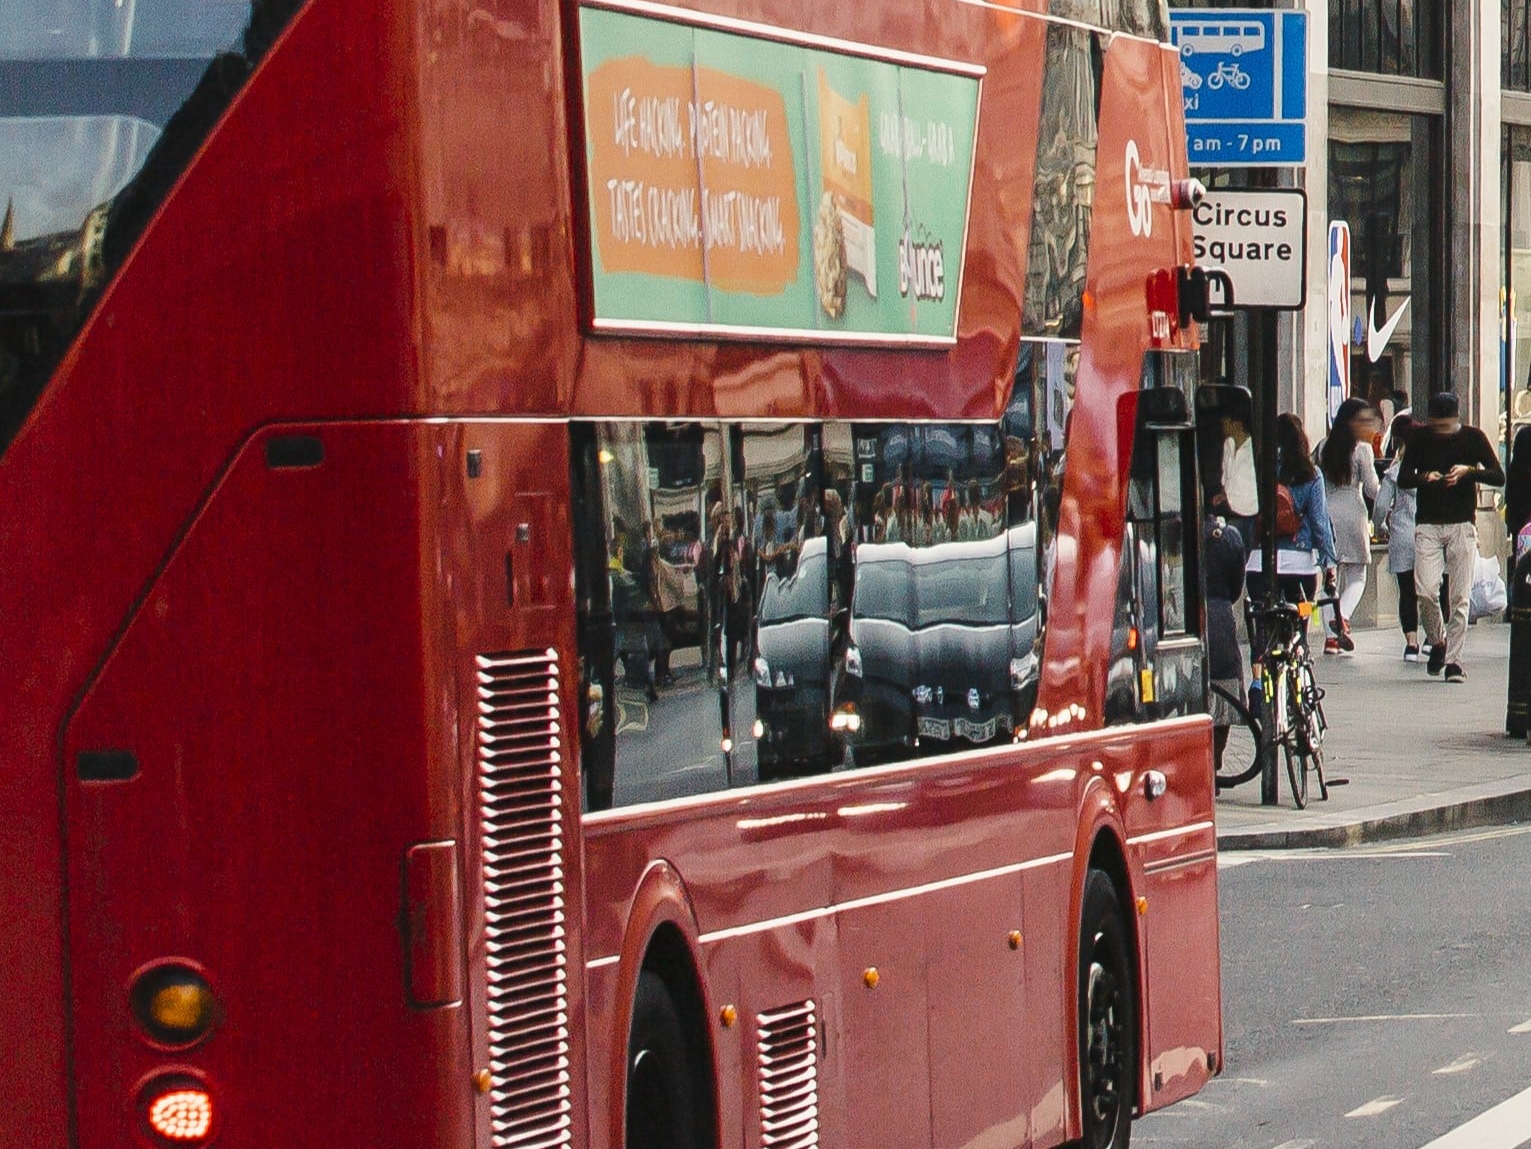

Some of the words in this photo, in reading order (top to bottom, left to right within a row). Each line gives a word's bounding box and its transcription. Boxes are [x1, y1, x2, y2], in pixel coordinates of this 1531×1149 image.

[1184, 94, 1199, 110] xi
[1185, 137, 1222, 151] am
[1125, 139, 1152, 238] Go
[1193, 202, 1287, 227] Circus
[1193, 236, 1292, 263] Square
